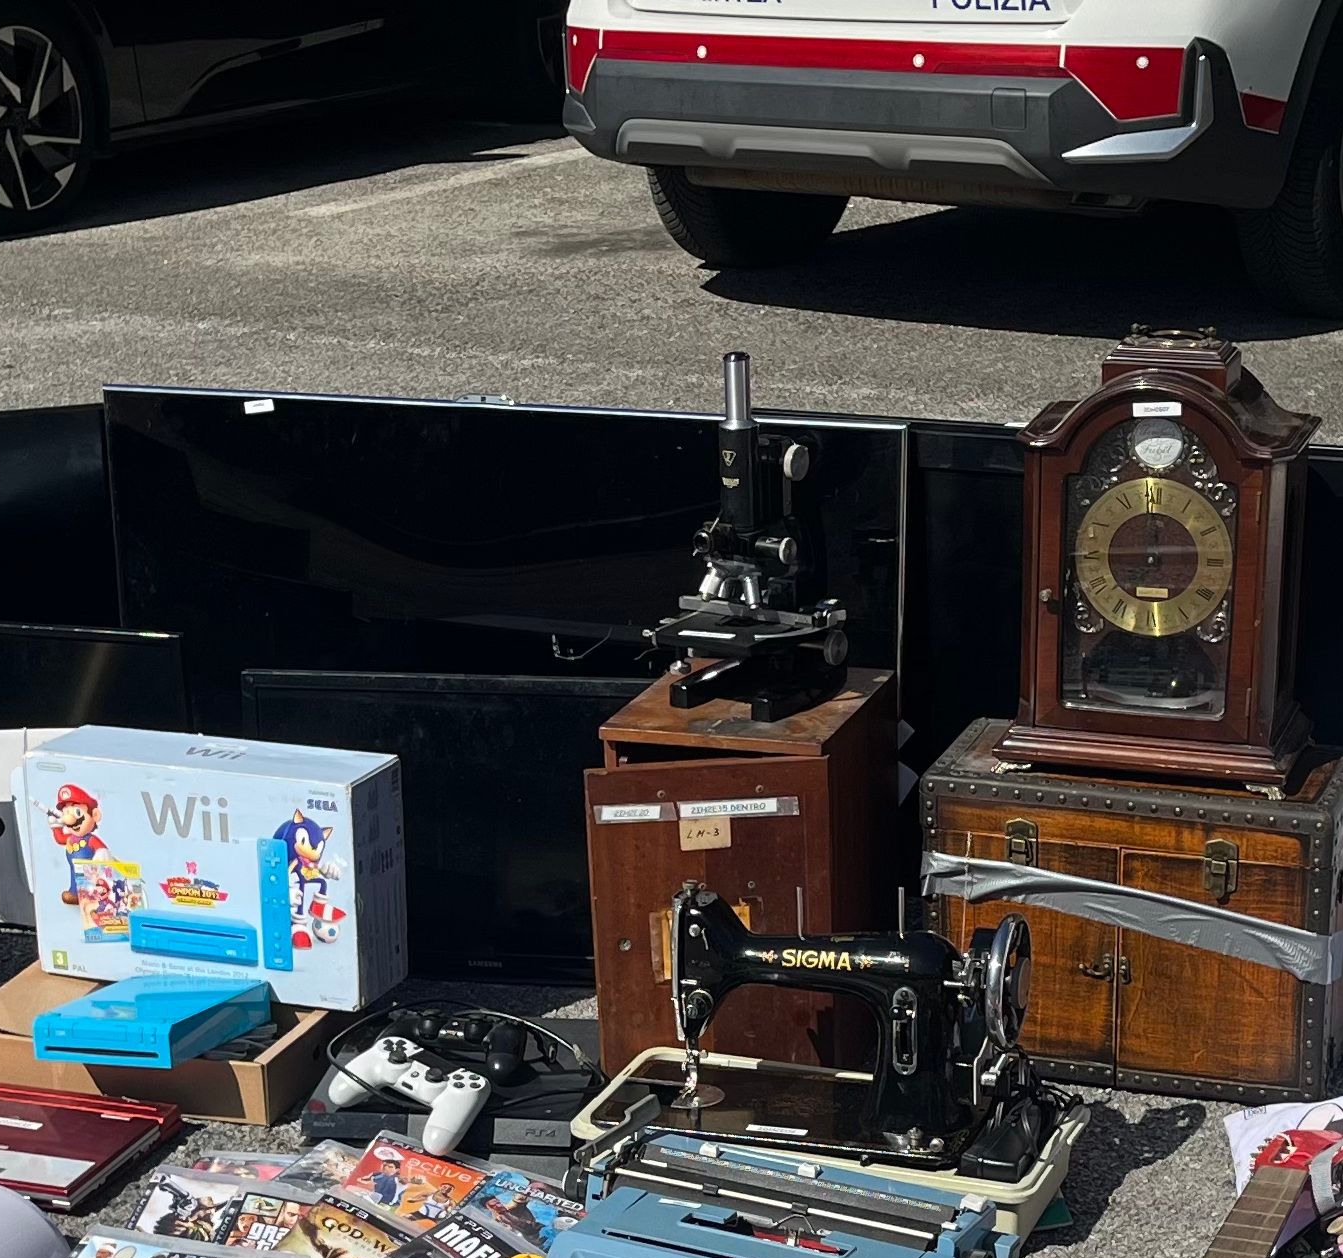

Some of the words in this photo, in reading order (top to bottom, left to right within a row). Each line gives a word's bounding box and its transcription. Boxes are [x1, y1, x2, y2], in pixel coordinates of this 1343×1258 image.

[186, 746, 249, 761] Wii
[306, 798, 339, 814] SEGA
[729, 802, 767, 813] DENTRO
[140, 790, 230, 844] Wii
[56, 951, 64, 964] 3
[781, 947, 852, 972] SIGMA
[72, 965, 89, 974] PAL
[524, 1128, 557, 1138] PS4
[406, 1157, 473, 1182] active
[494, 1178, 586, 1211] UNCHARTED
[336, 1201, 369, 1220] PS3
[321, 1216, 365, 1240] GOD
[464, 1219, 494, 1240] PS3
